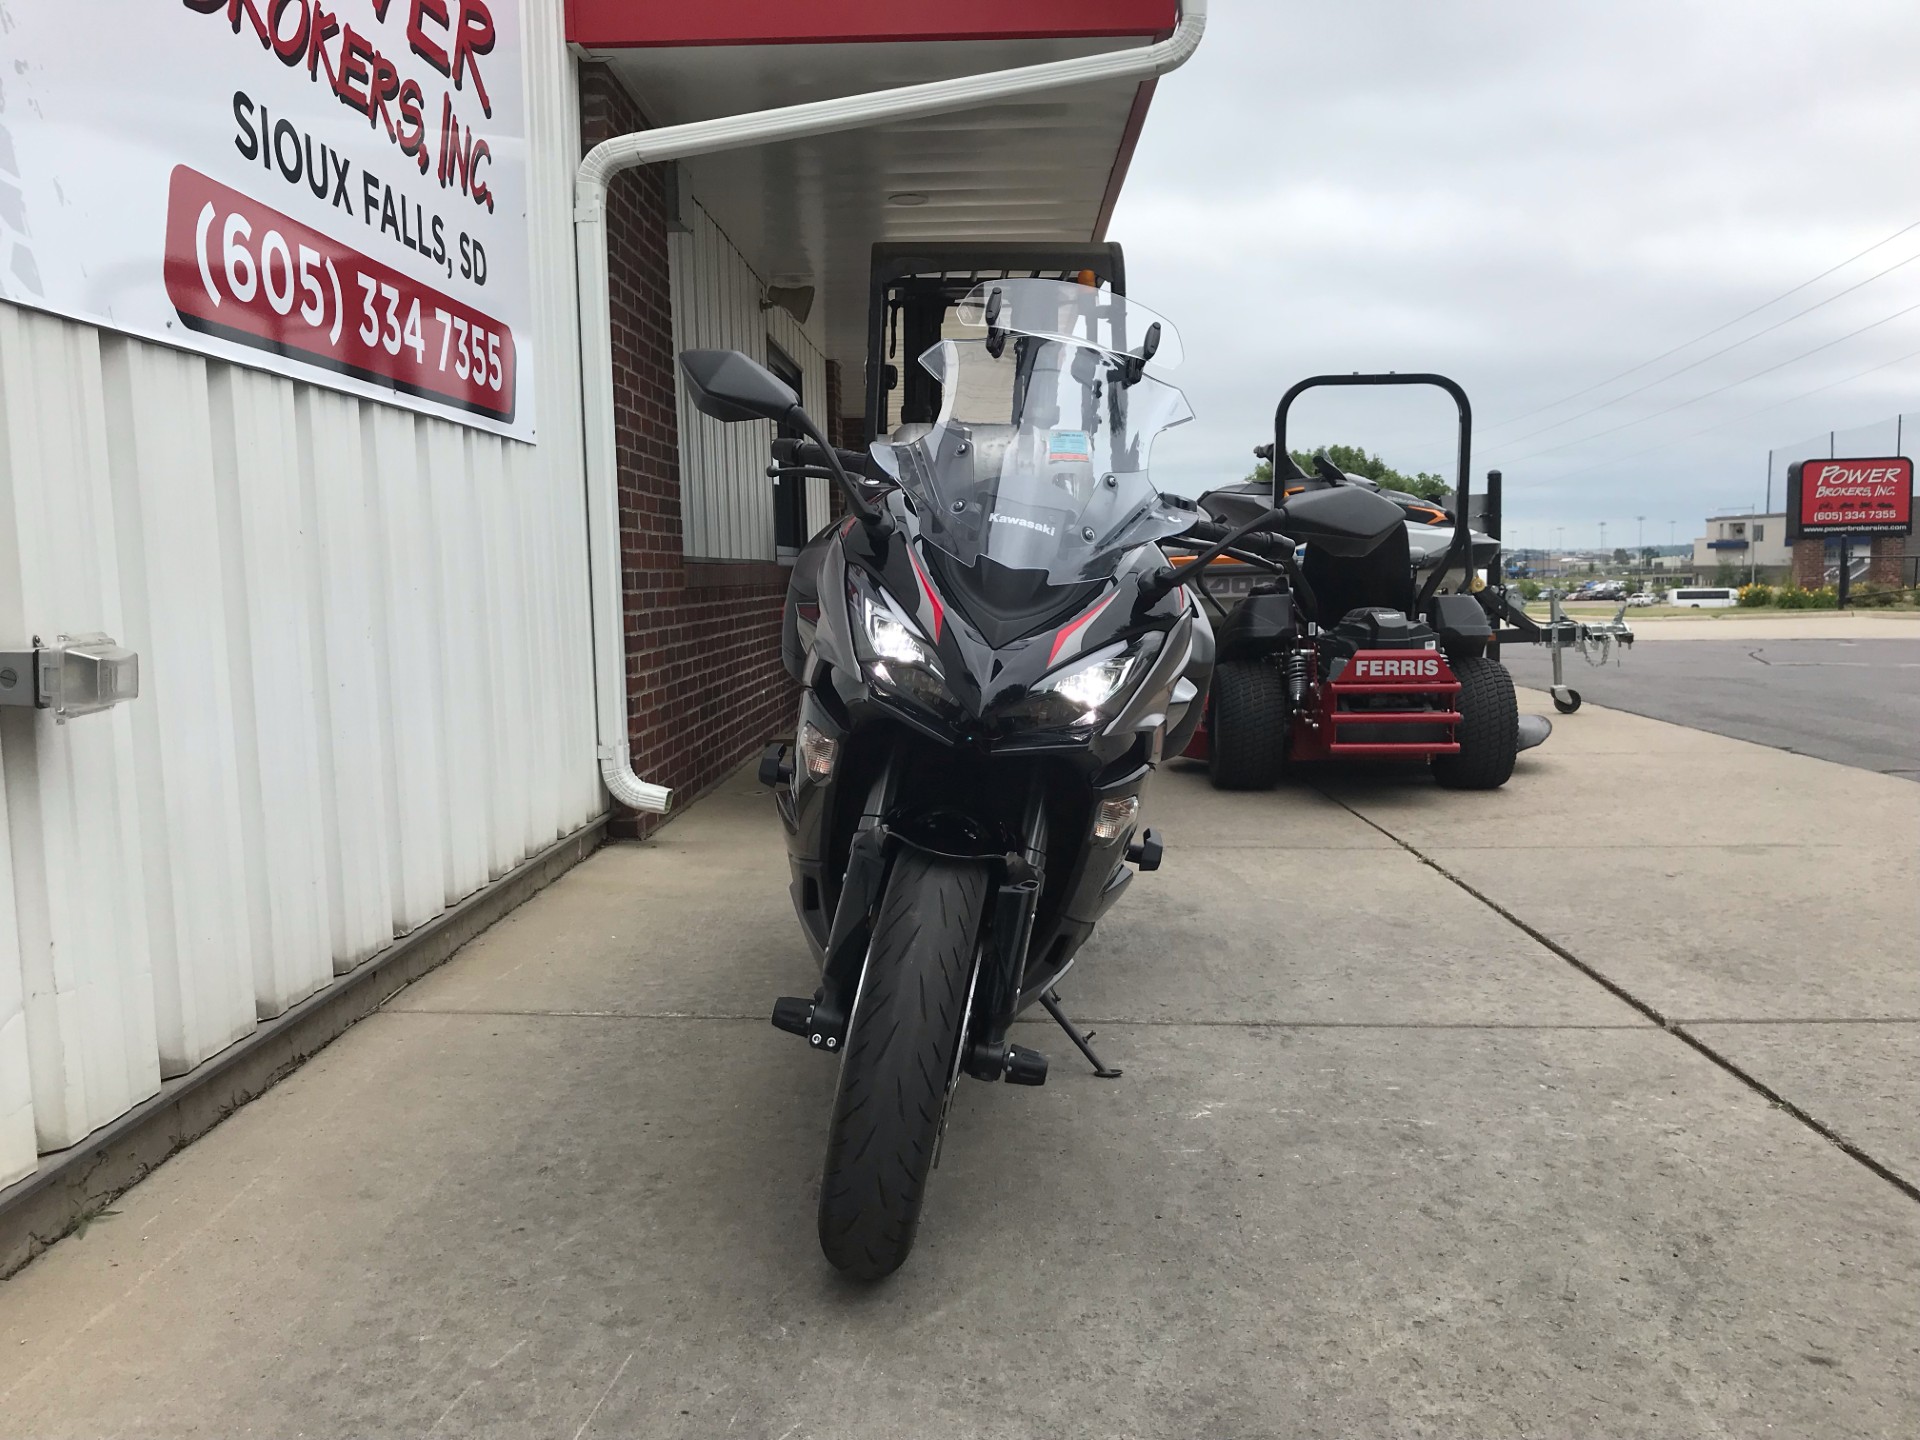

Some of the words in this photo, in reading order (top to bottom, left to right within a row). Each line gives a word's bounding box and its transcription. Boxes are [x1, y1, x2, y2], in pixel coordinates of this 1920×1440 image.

[438, 91, 494, 214] INC.
[233, 90, 354, 217] SIOUX
[362, 169, 452, 279] FALLS,
[459, 231, 488, 287] SD
[195, 200, 344, 347] (605)
[357, 271, 425, 365] 334
[435, 307, 503, 392] 7355
[1817, 465, 1902, 486] POWER
[1815, 486, 1872, 498] BROKERS,
[1874, 484, 1896, 497] INC.
[988, 512, 1056, 536] Kawasaki
[1813, 511, 1843, 521] (605)
[1845, 510, 1866, 520] 334
[1868, 510, 1897, 519] 7355
[1355, 659, 1439, 676] FERRIS
